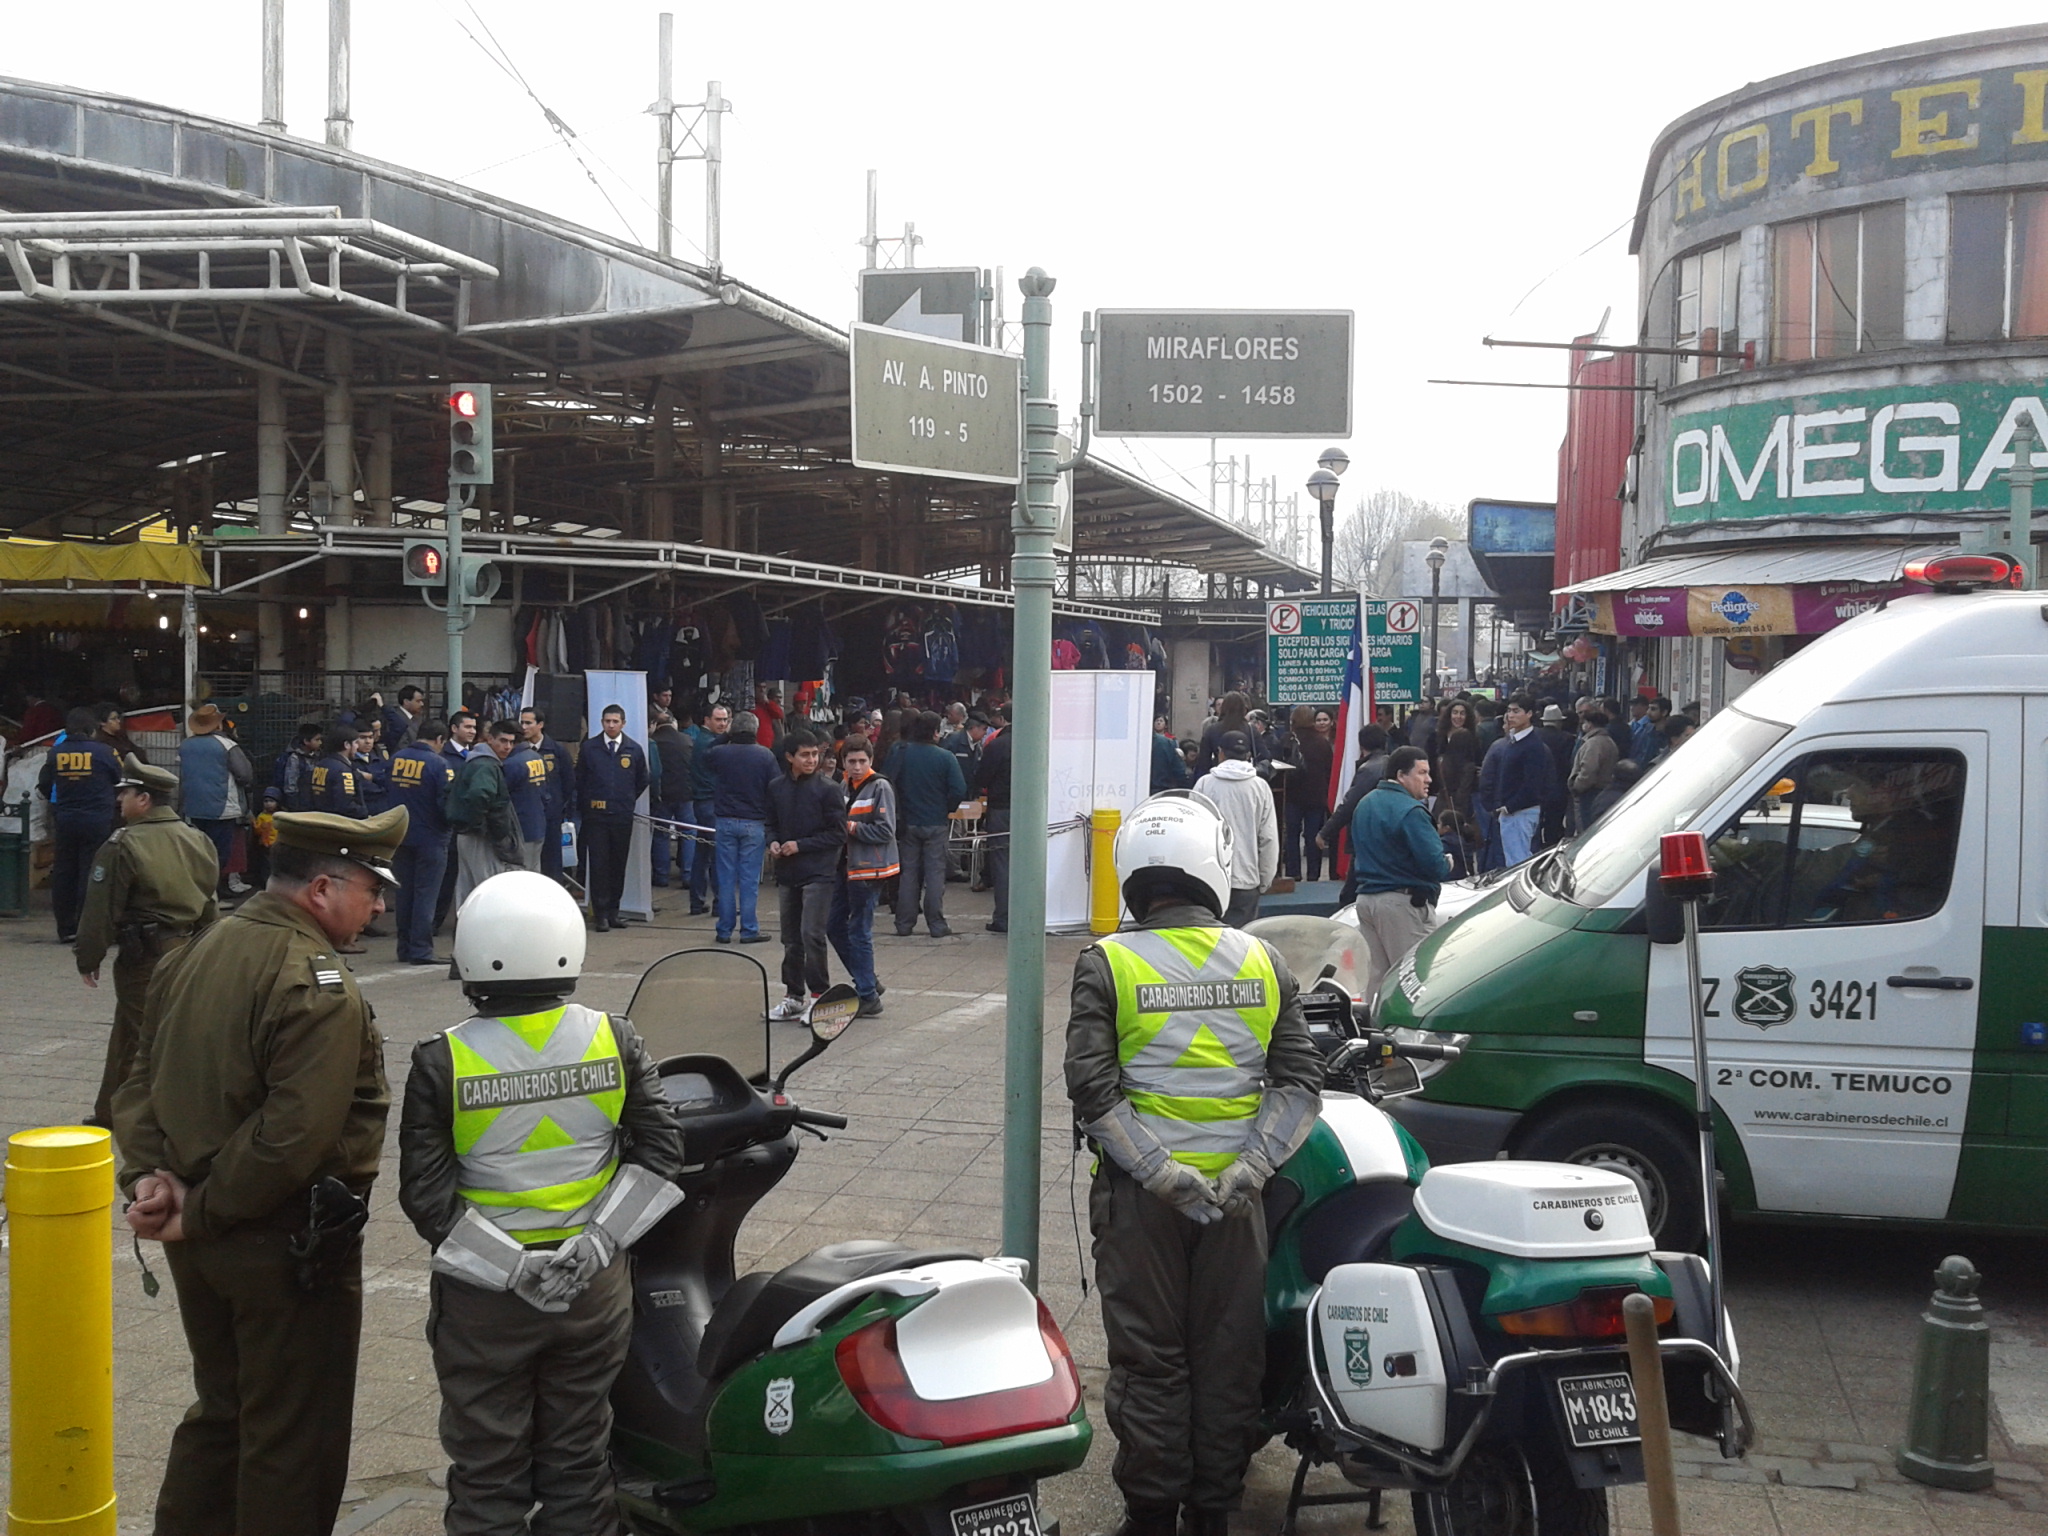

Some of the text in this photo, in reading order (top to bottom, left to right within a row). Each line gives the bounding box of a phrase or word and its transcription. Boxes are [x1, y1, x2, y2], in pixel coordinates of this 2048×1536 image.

[1147, 336, 1299, 361] MIRAFLORES
[883, 359, 988, 399] AV. A. PINTO
[1149, 384, 1203, 404] 1502
[1241, 385, 1296, 405] 1458
[908, 415, 935, 438] 119
[959, 422, 968, 443] 5
[1711, 601, 1760, 614] Pedigree
[1835, 602, 1880, 618] whisk
[1321, 618, 1355, 630] Y TRICIC
[1634, 611, 1664, 625] whiskas
[1278, 636, 1309, 647] EXCEPTO
[1310, 636, 1320, 646] EN
[1321, 636, 1335, 646] LOS
[1376, 635, 1413, 645] HORARIOS
[1278, 648, 1298, 659] SOLO
[1299, 648, 1318, 658] PARA
[1320, 647, 1345, 658] CARGA
[1278, 692, 1297, 701] SOLO
[1298, 691, 1336, 701] VEHICULOS
[1381, 690, 1391, 699] DE
[1391, 689, 1412, 699] GOMA
[57, 752, 92, 770] PDI
[391, 757, 425, 779] PDI
[526, 759, 545, 777] PDI
[312, 767, 328, 785] PDI
[1135, 816, 1184, 826] CARABINEROS
[1141, 982, 1261, 1008] CARABINEROS DE CHILE
[1809, 979, 1877, 1020] 3421
[463, 1062, 616, 1106] CARABINEROS DE CHILE
[1749, 1069, 1820, 1090] COM.
[1831, 1072, 1952, 1095] TEMUCO
[1754, 1110, 1948, 1128] www.carabinerosdechile.cl
[1533, 1194, 1639, 1210] CARABINEROS DE CHILE
[1327, 1304, 1389, 1323] CARABINEROS DE CHILE
[1588, 1426, 1630, 1439] DE CHILE
